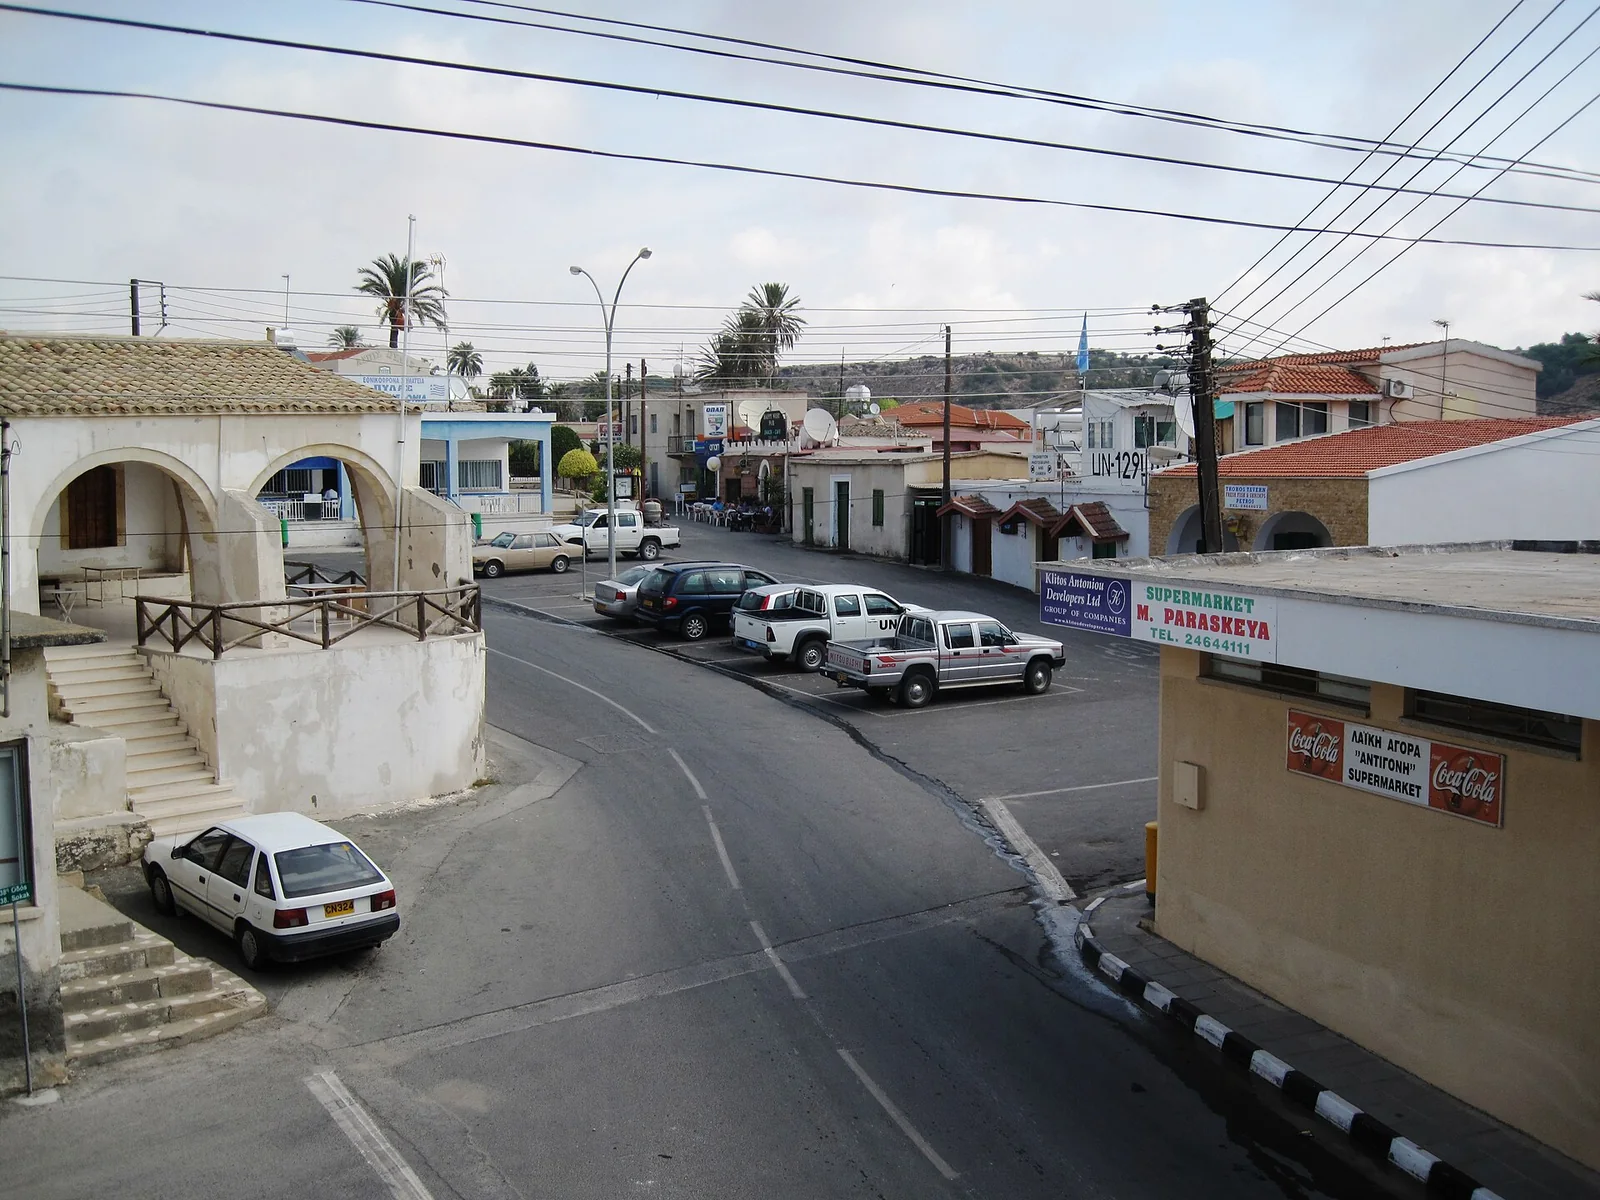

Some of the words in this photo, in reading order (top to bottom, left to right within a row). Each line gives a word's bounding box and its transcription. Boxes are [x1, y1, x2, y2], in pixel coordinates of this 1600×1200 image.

[1045, 572, 1067, 585] Klitos
[1068, 575, 1104, 591] Antoniou
[1046, 588, 1085, 607] Developers
[1086, 593, 1101, 607] Ltd
[1146, 586, 1254, 613] SUPERMARKET
[880, 619, 897, 630] UN
[1044, 605, 1067, 615] GROUP
[1083, 612, 1126, 625] COMPANIES
[1137, 604, 1153, 622] M.
[1164, 608, 1270, 640] PARASKEYA
[1150, 627, 1178, 642] TEL.
[1185, 633, 1250, 655] 24644111
[829, 652, 861, 668] MITSUBISHI
[1289, 726, 1340, 763] Coca-Cola
[1351, 730, 1382, 749] ΛΑΪΚΗ
[1387, 738, 1421, 758] ΑΓΟΡΑ
[1348, 768, 1422, 798] SUPERMARKET
[1432, 760, 1498, 803] Coca-Cola
